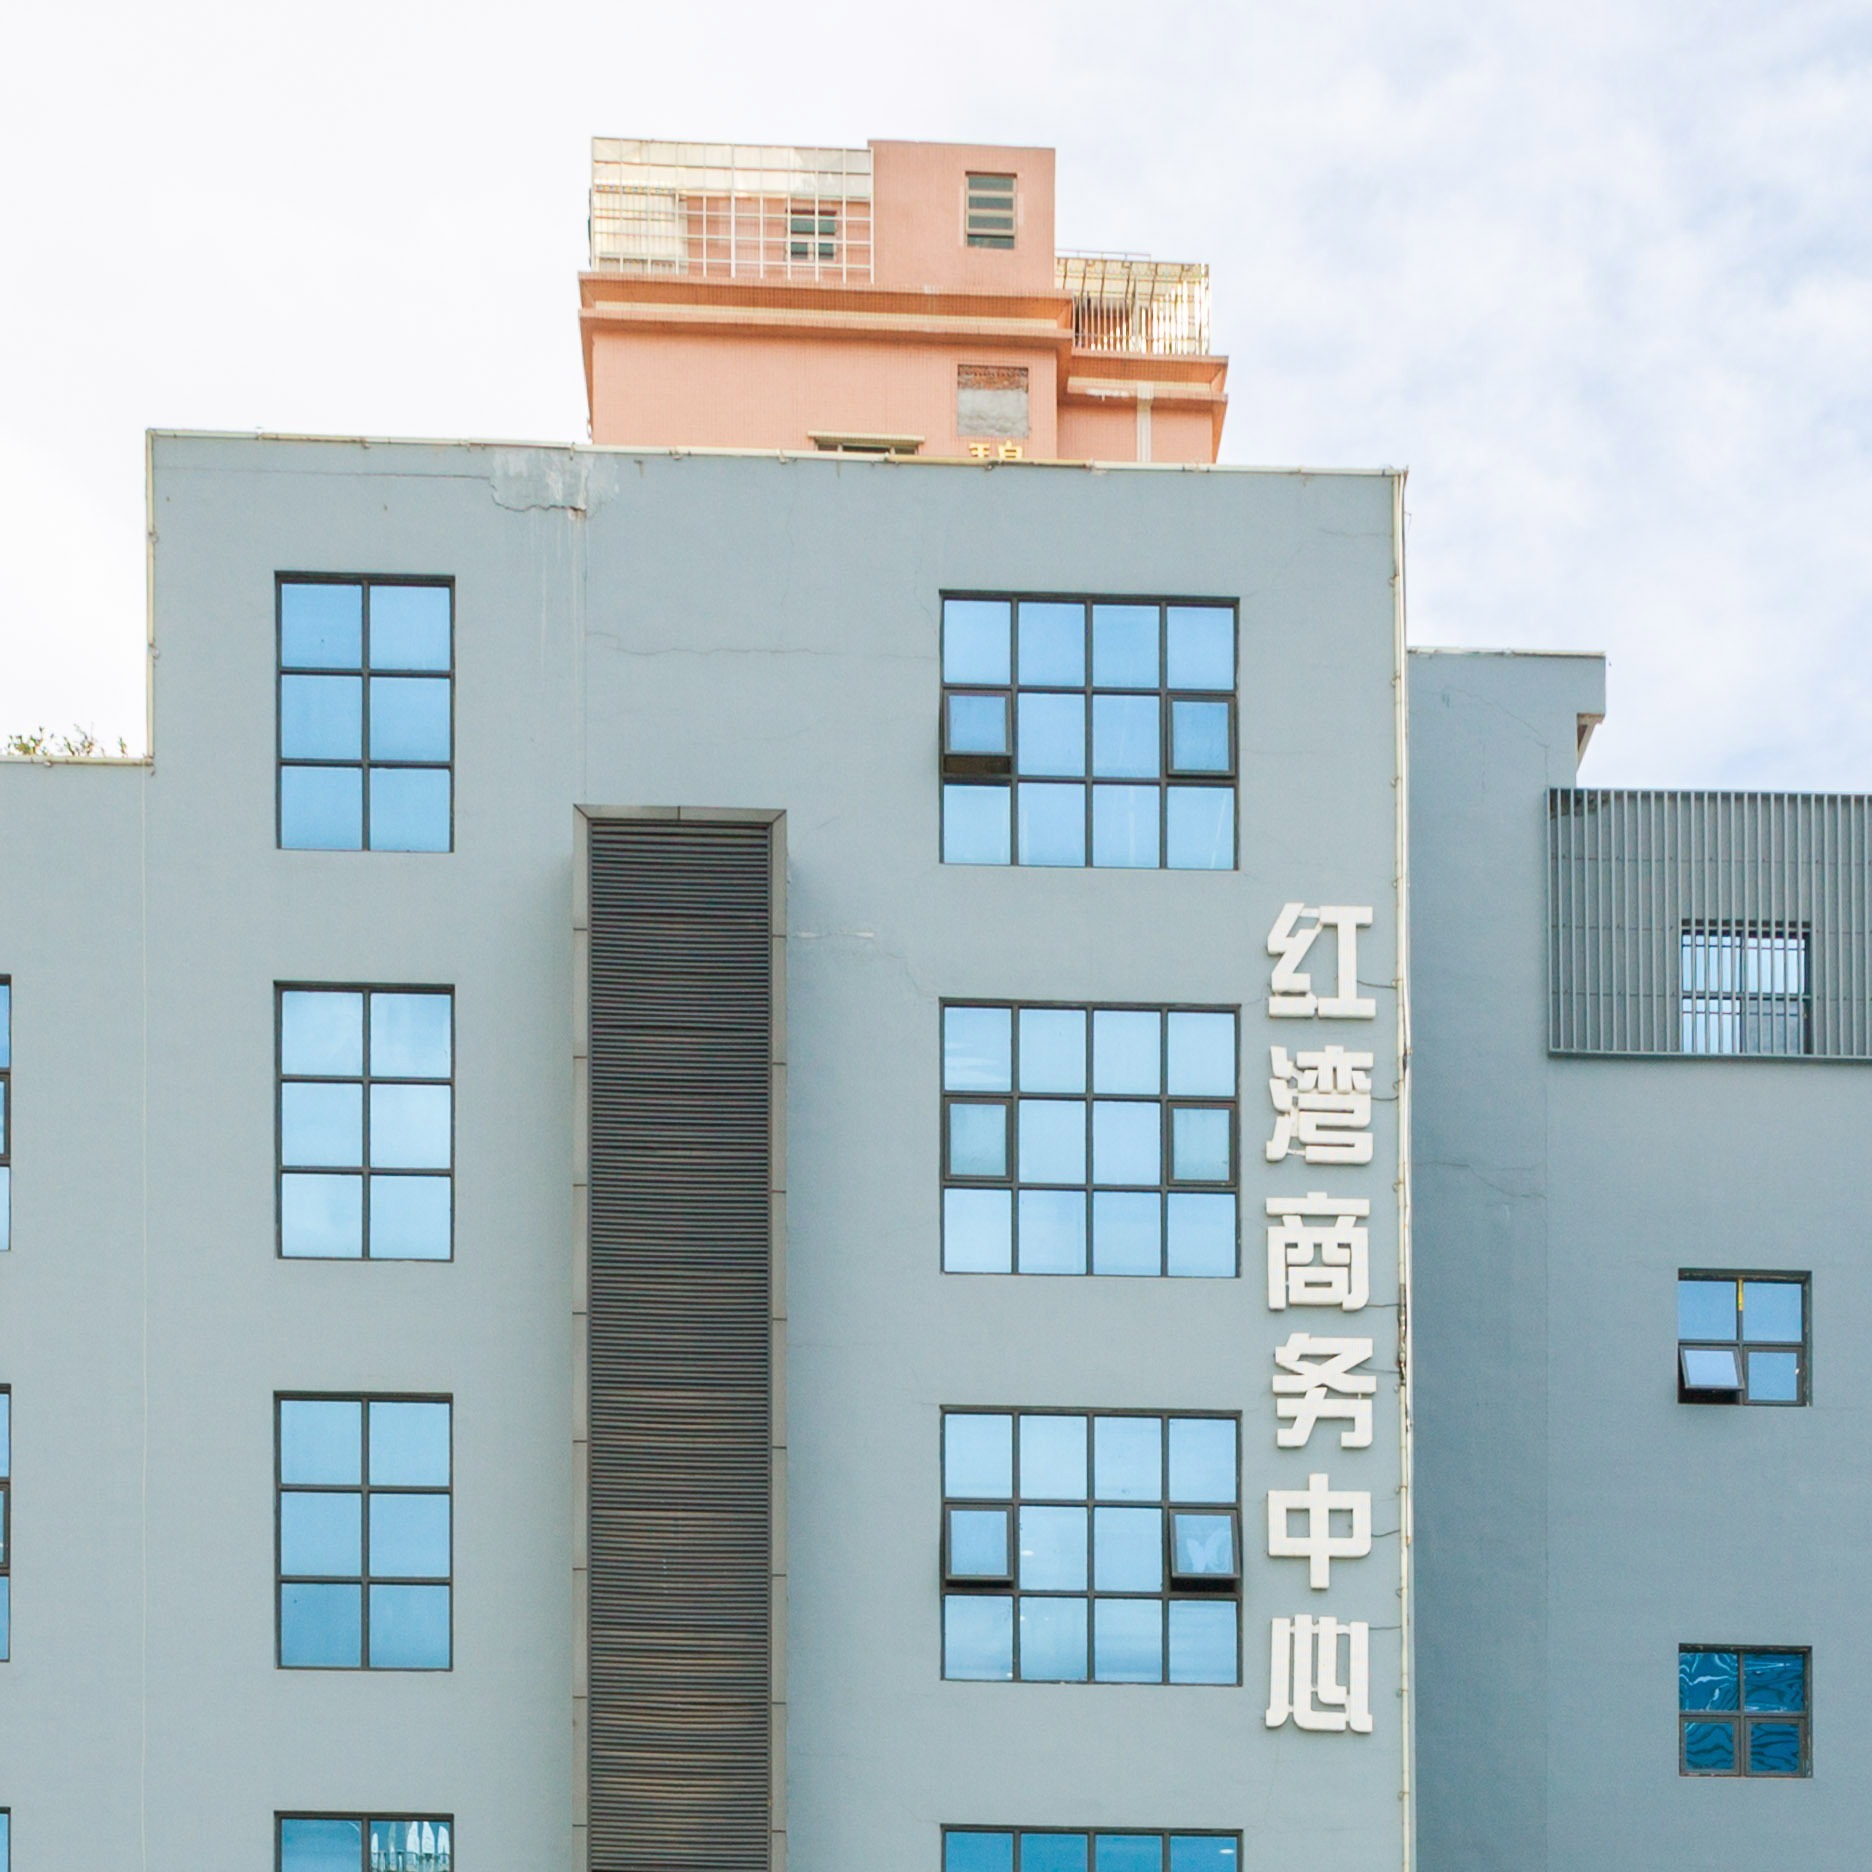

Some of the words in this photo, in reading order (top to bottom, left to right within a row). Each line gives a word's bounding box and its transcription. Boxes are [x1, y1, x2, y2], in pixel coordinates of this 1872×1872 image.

[1265, 901, 1377, 1734] 红湾商务中心
